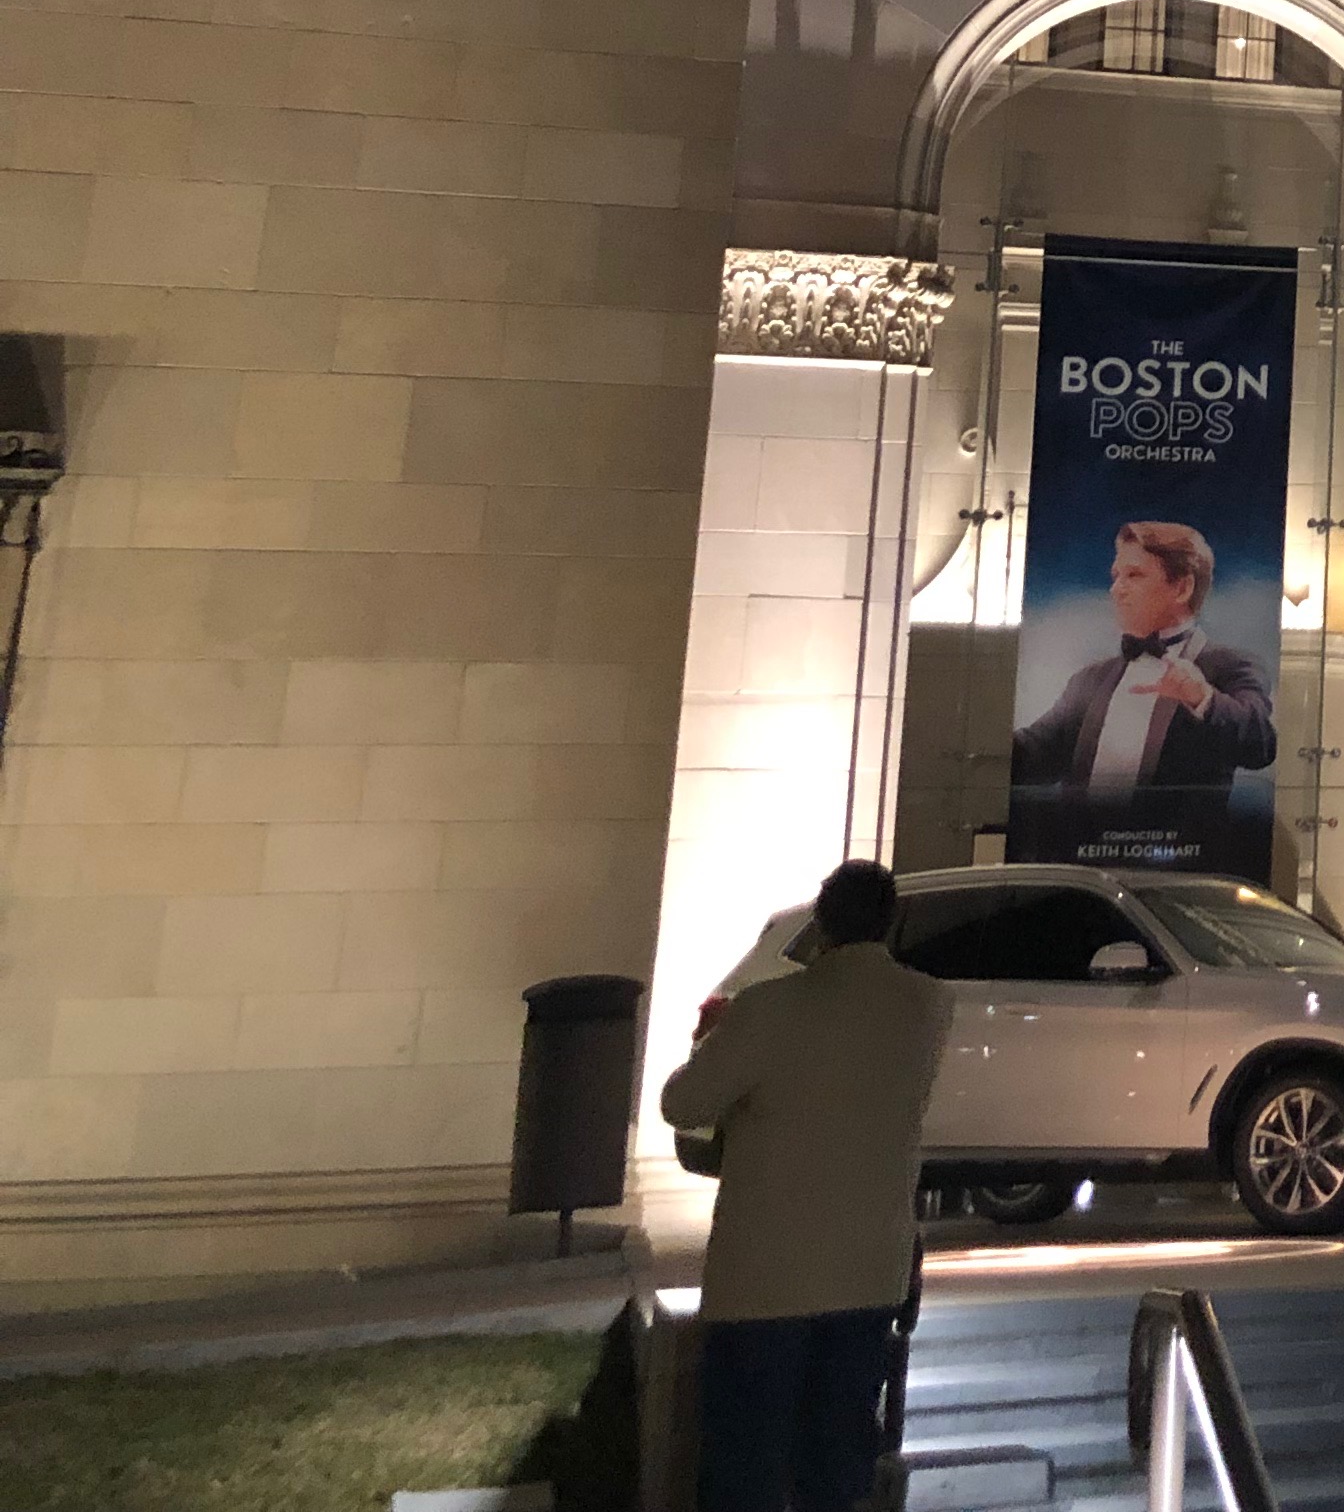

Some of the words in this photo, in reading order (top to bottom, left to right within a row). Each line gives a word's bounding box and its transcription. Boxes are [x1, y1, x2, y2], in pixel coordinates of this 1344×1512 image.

[1151, 339, 1184, 356] THE
[1060, 355, 1269, 400] BOSTON
[1090, 397, 1235, 444] POPS
[1105, 443, 1217, 463] ORCHESTRA
[1102, 830, 1165, 841] CONDUCTED
[1165, 830, 1179, 840] BY
[1077, 844, 1120, 858] KEITH
[1123, 844, 1201, 858] LOCKHART
